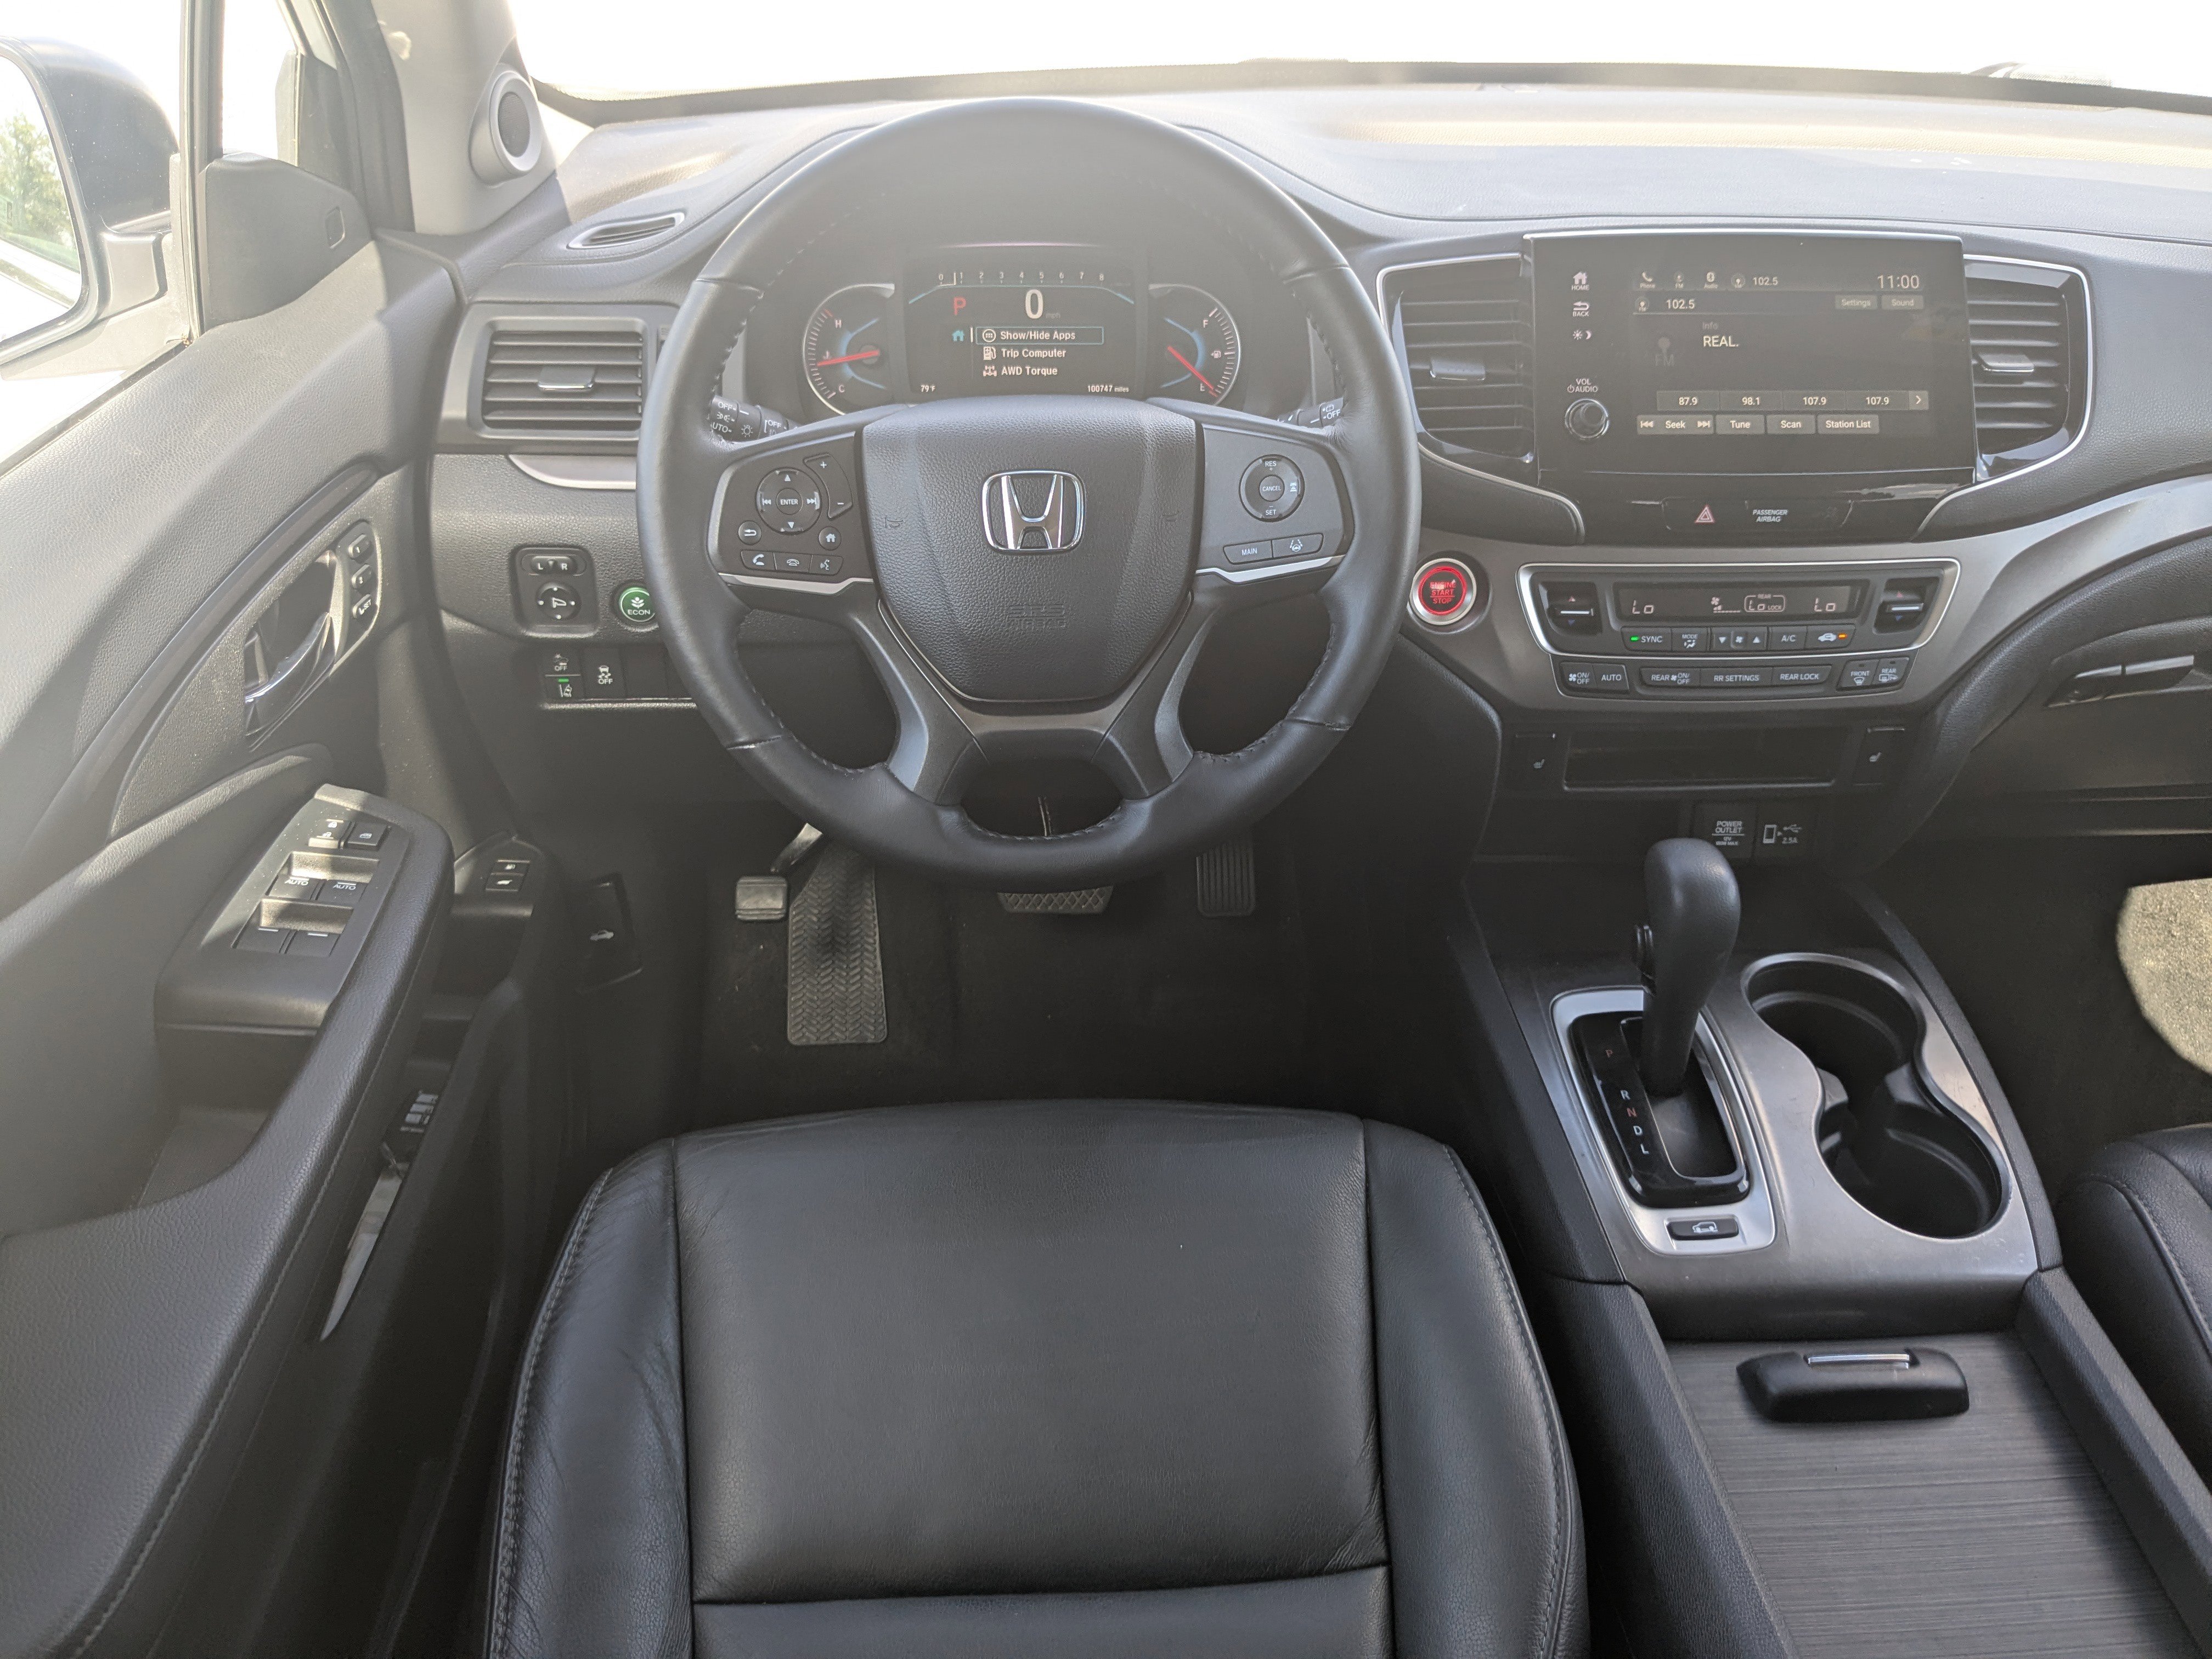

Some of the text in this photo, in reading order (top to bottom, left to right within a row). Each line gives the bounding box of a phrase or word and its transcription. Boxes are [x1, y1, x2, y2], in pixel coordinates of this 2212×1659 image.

[1752, 276, 1778, 286] 102.5
[1877, 274, 1919, 289] 11:00
[953, 297, 967, 315] P
[1025, 289, 1044, 319] 0
[1666, 298, 1695, 309] 102.5
[1842, 298, 1871, 308] Settings
[1892, 298, 1914, 307] Sound
[835, 319, 842, 328] H
[1203, 319, 1208, 328] F
[1000, 331, 1075, 341] Show/Hide Apps
[1703, 335, 1739, 347] REAL.
[1001, 348, 1066, 359] Trip Computer
[1001, 366, 1058, 377] AWD Torque
[838, 385, 845, 393] C
[1679, 397, 1698, 405] 87.9
[1742, 397, 1760, 405] 98.1
[1803, 397, 1827, 405] 107.9
[1865, 397, 1889, 405] 107.9
[718, 402, 733, 411] OFF
[1327, 409, 1341, 419] OFF
[768, 420, 781, 428] OFF
[1665, 420, 1686, 429] Seek
[1780, 420, 1801, 428] Scan
[1825, 420, 1871, 428] Station List
[1605, 1049, 1614, 1058] P
[1621, 1090, 1630, 1100] R
[1627, 1108, 1638, 1118] N
[1633, 1126, 1643, 1136] D
[1640, 1144, 1649, 1154] L
